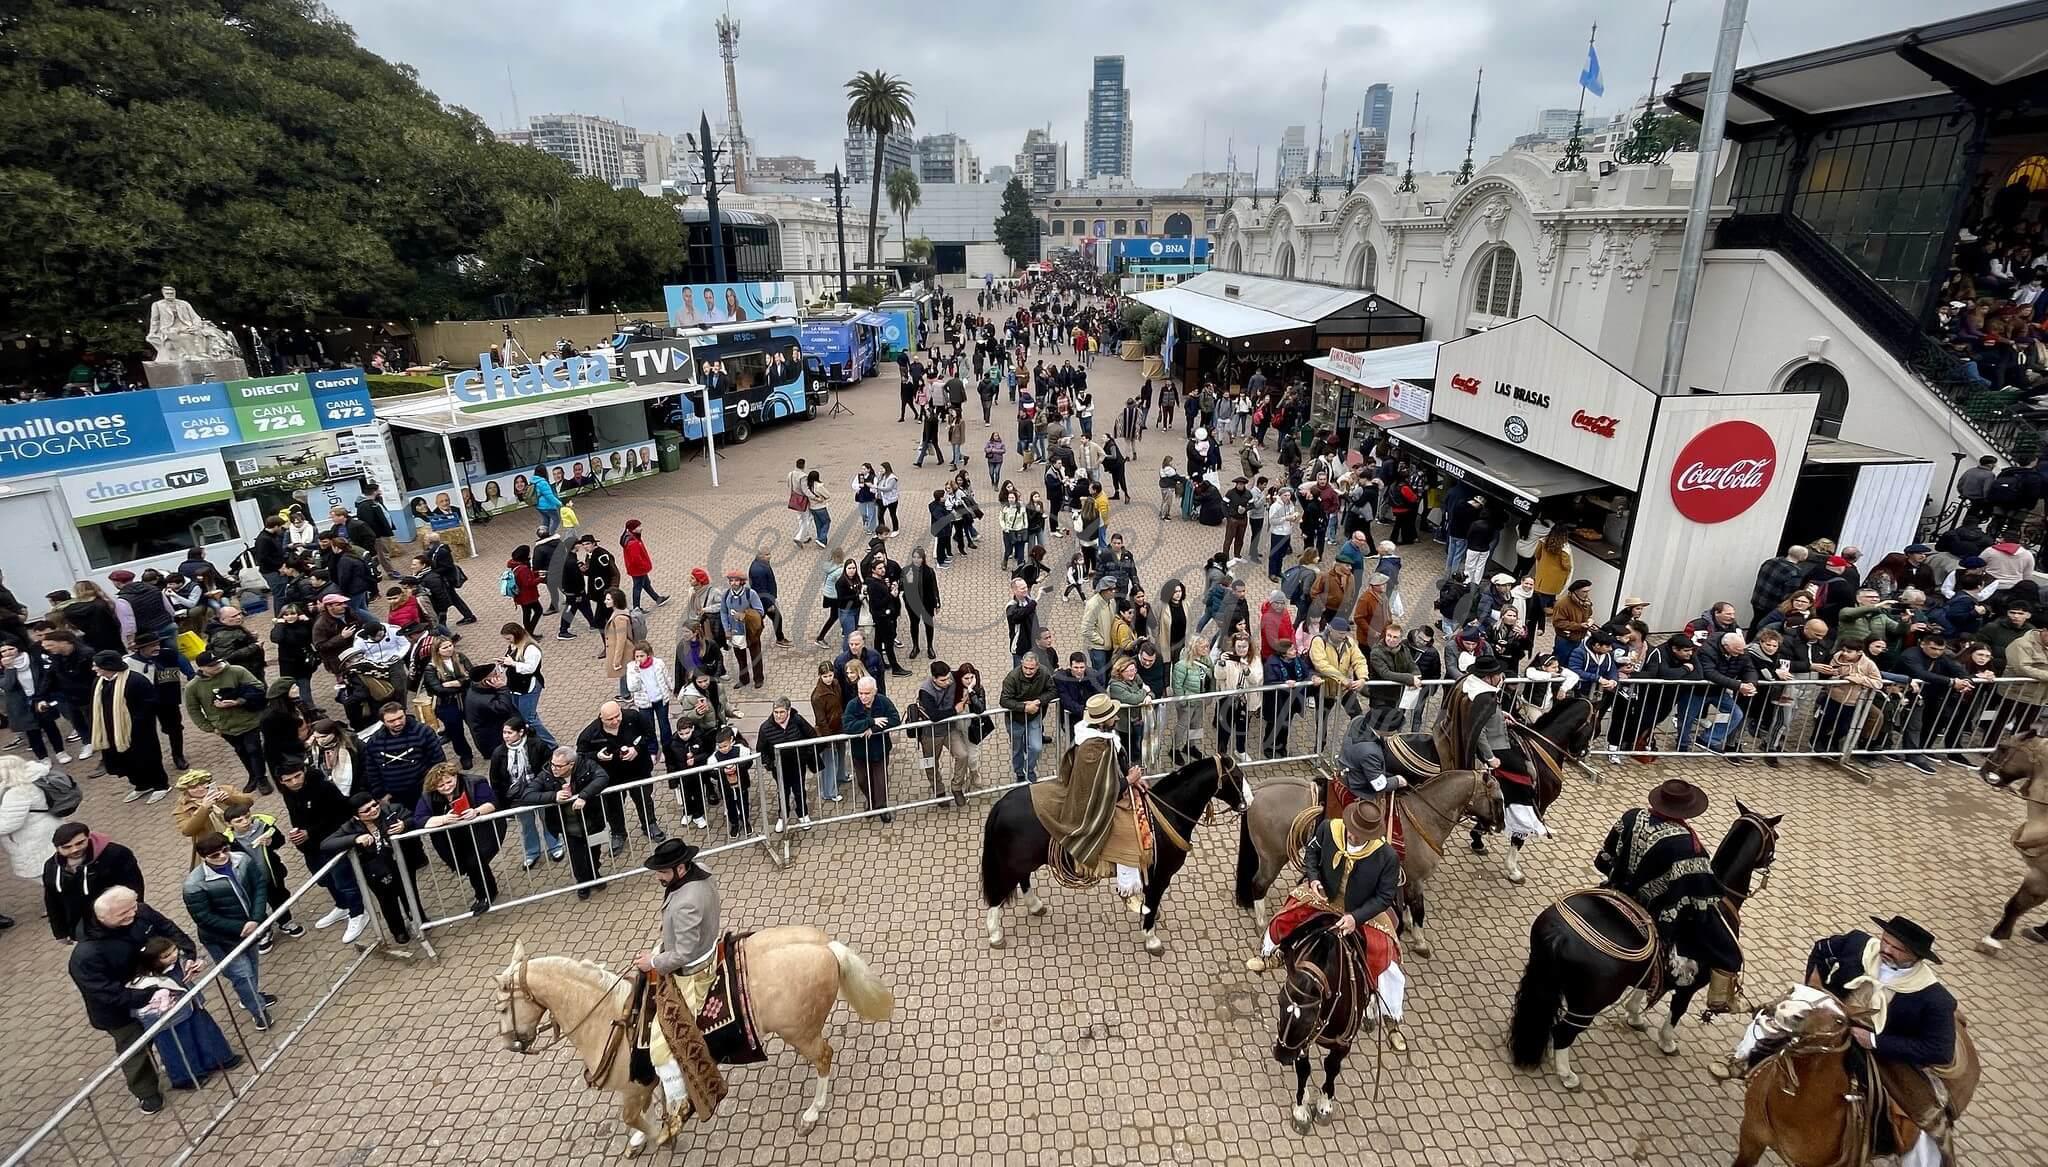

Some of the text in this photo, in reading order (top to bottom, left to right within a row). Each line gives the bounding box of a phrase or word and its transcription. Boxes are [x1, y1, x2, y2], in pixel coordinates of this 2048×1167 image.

[1165, 244, 1185, 253] BNA
[315, 376, 359, 389] ClaroTV
[453, 348, 671, 403] chacra TV
[241, 382, 300, 398] DIRECTV
[1494, 381, 1512, 398] LAS
[1513, 387, 1551, 409] BRASAS
[178, 393, 211, 405] Flow
[325, 398, 362, 410] CANAL
[252, 404, 301, 418] CANAL
[328, 406, 366, 420] 472
[0, 414, 126, 442] millones
[181, 416, 225, 429] CANAL
[253, 414, 306, 432] 724
[183, 424, 230, 441] 429
[0, 429, 131, 462] HOGARES
[287, 469, 319, 481] chacra
[1436, 458, 1465, 479] LAS BRASAS
[1677, 457, 1772, 492] Coca-Cola
[86, 470, 194, 501] chacra TV
